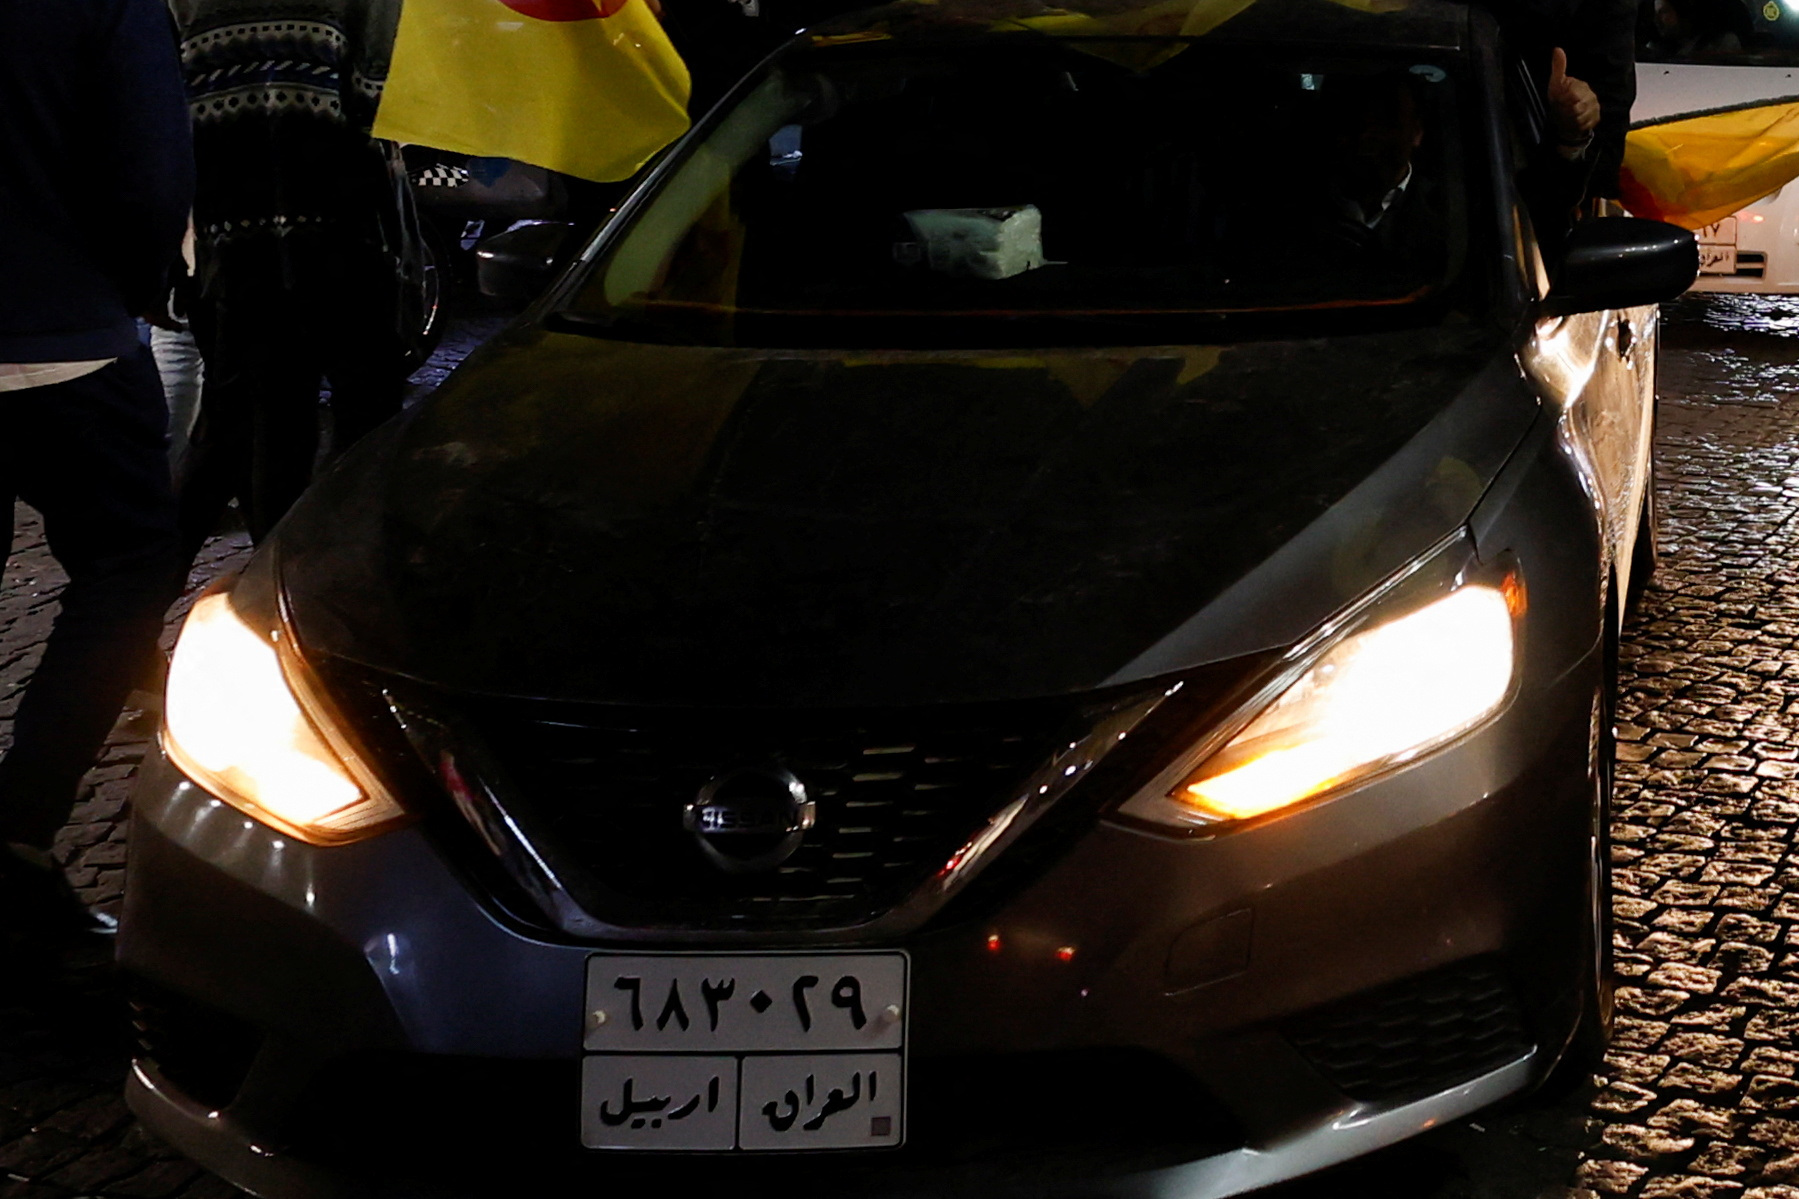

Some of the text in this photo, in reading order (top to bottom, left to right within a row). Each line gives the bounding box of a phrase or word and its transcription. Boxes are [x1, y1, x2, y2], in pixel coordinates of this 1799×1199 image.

[701, 806, 795, 831] NISSAN
[614, 975, 867, 1033] ٦٨٣٠٢٩
[600, 1070, 877, 1132] العراق اربيل
